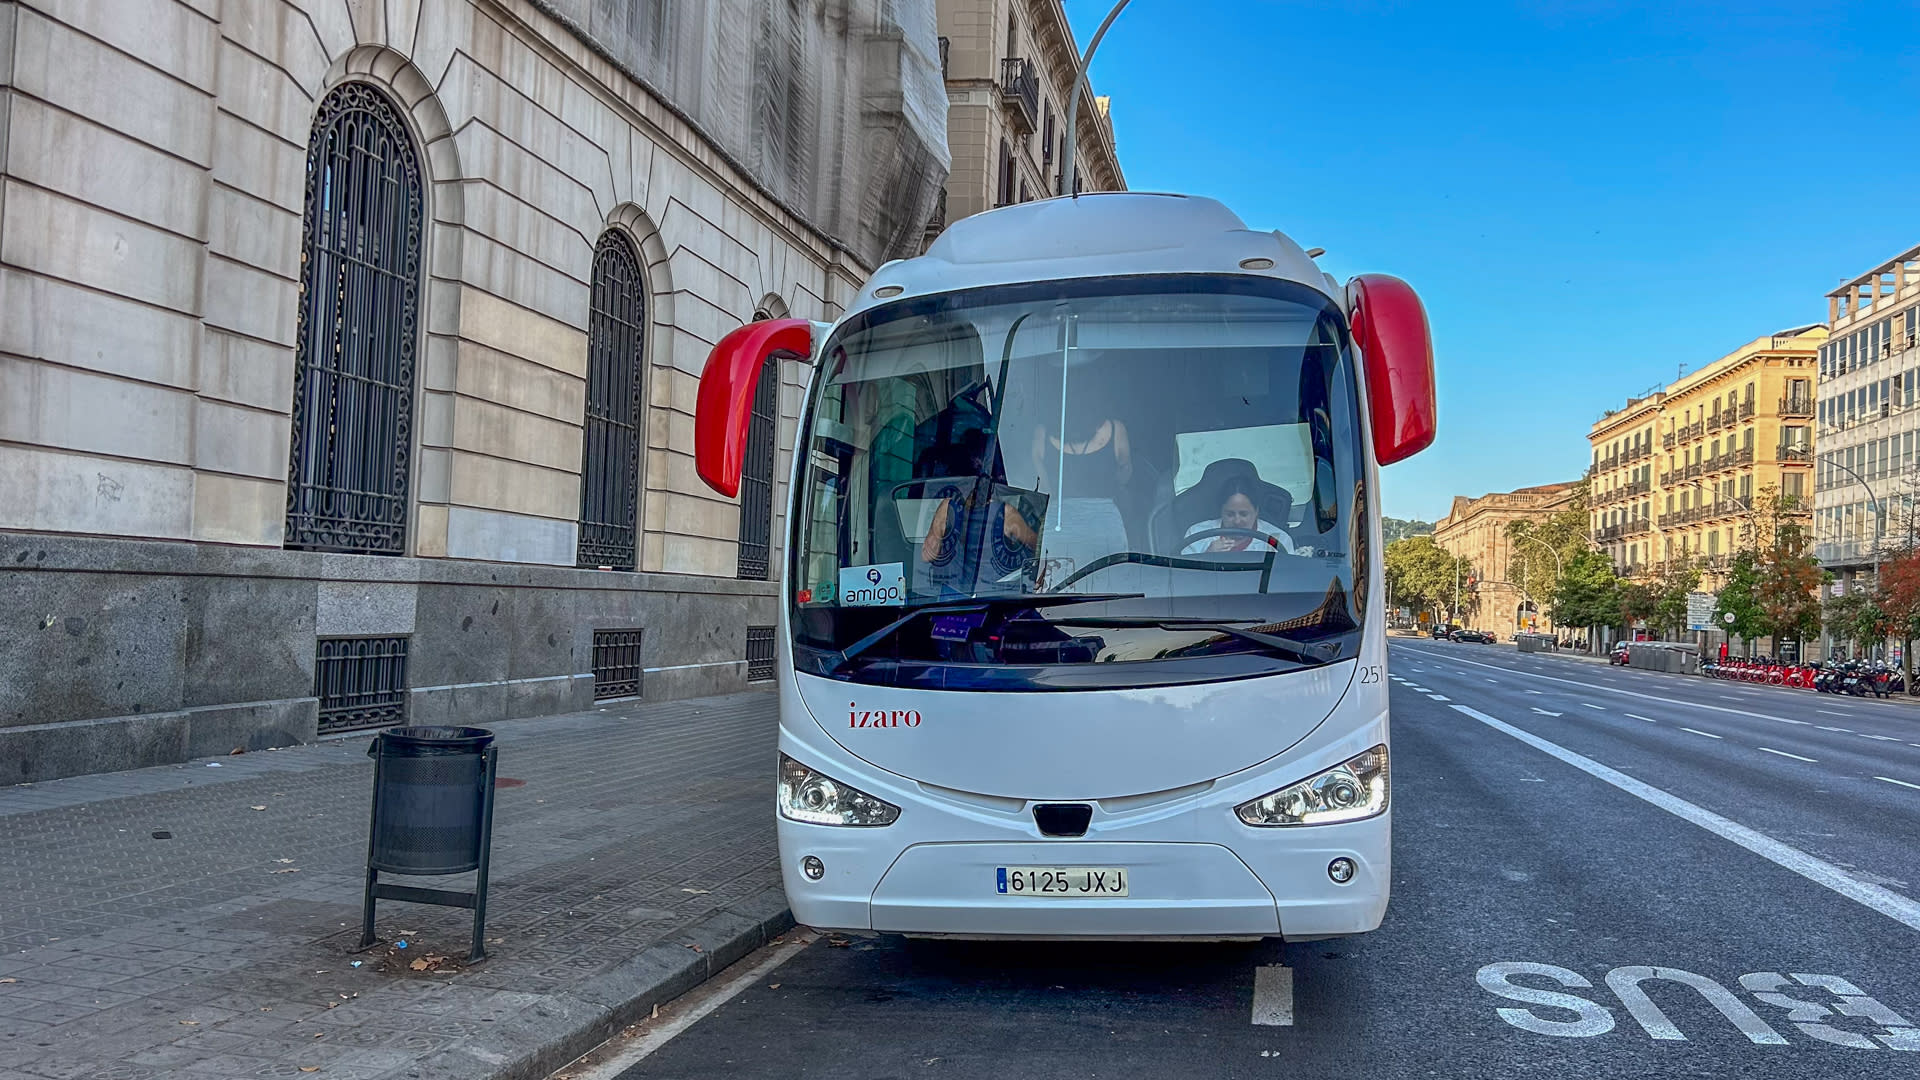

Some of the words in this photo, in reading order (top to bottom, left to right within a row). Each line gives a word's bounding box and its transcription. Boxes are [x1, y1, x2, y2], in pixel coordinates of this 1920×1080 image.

[845, 586, 898, 605] amigo
[1360, 665, 1383, 684] 251
[848, 701, 922, 729] izaro
[1011, 870, 1069, 893] 6125
[1079, 871, 1123, 893] JXJ
[1475, 960, 1920, 1052] BUS
